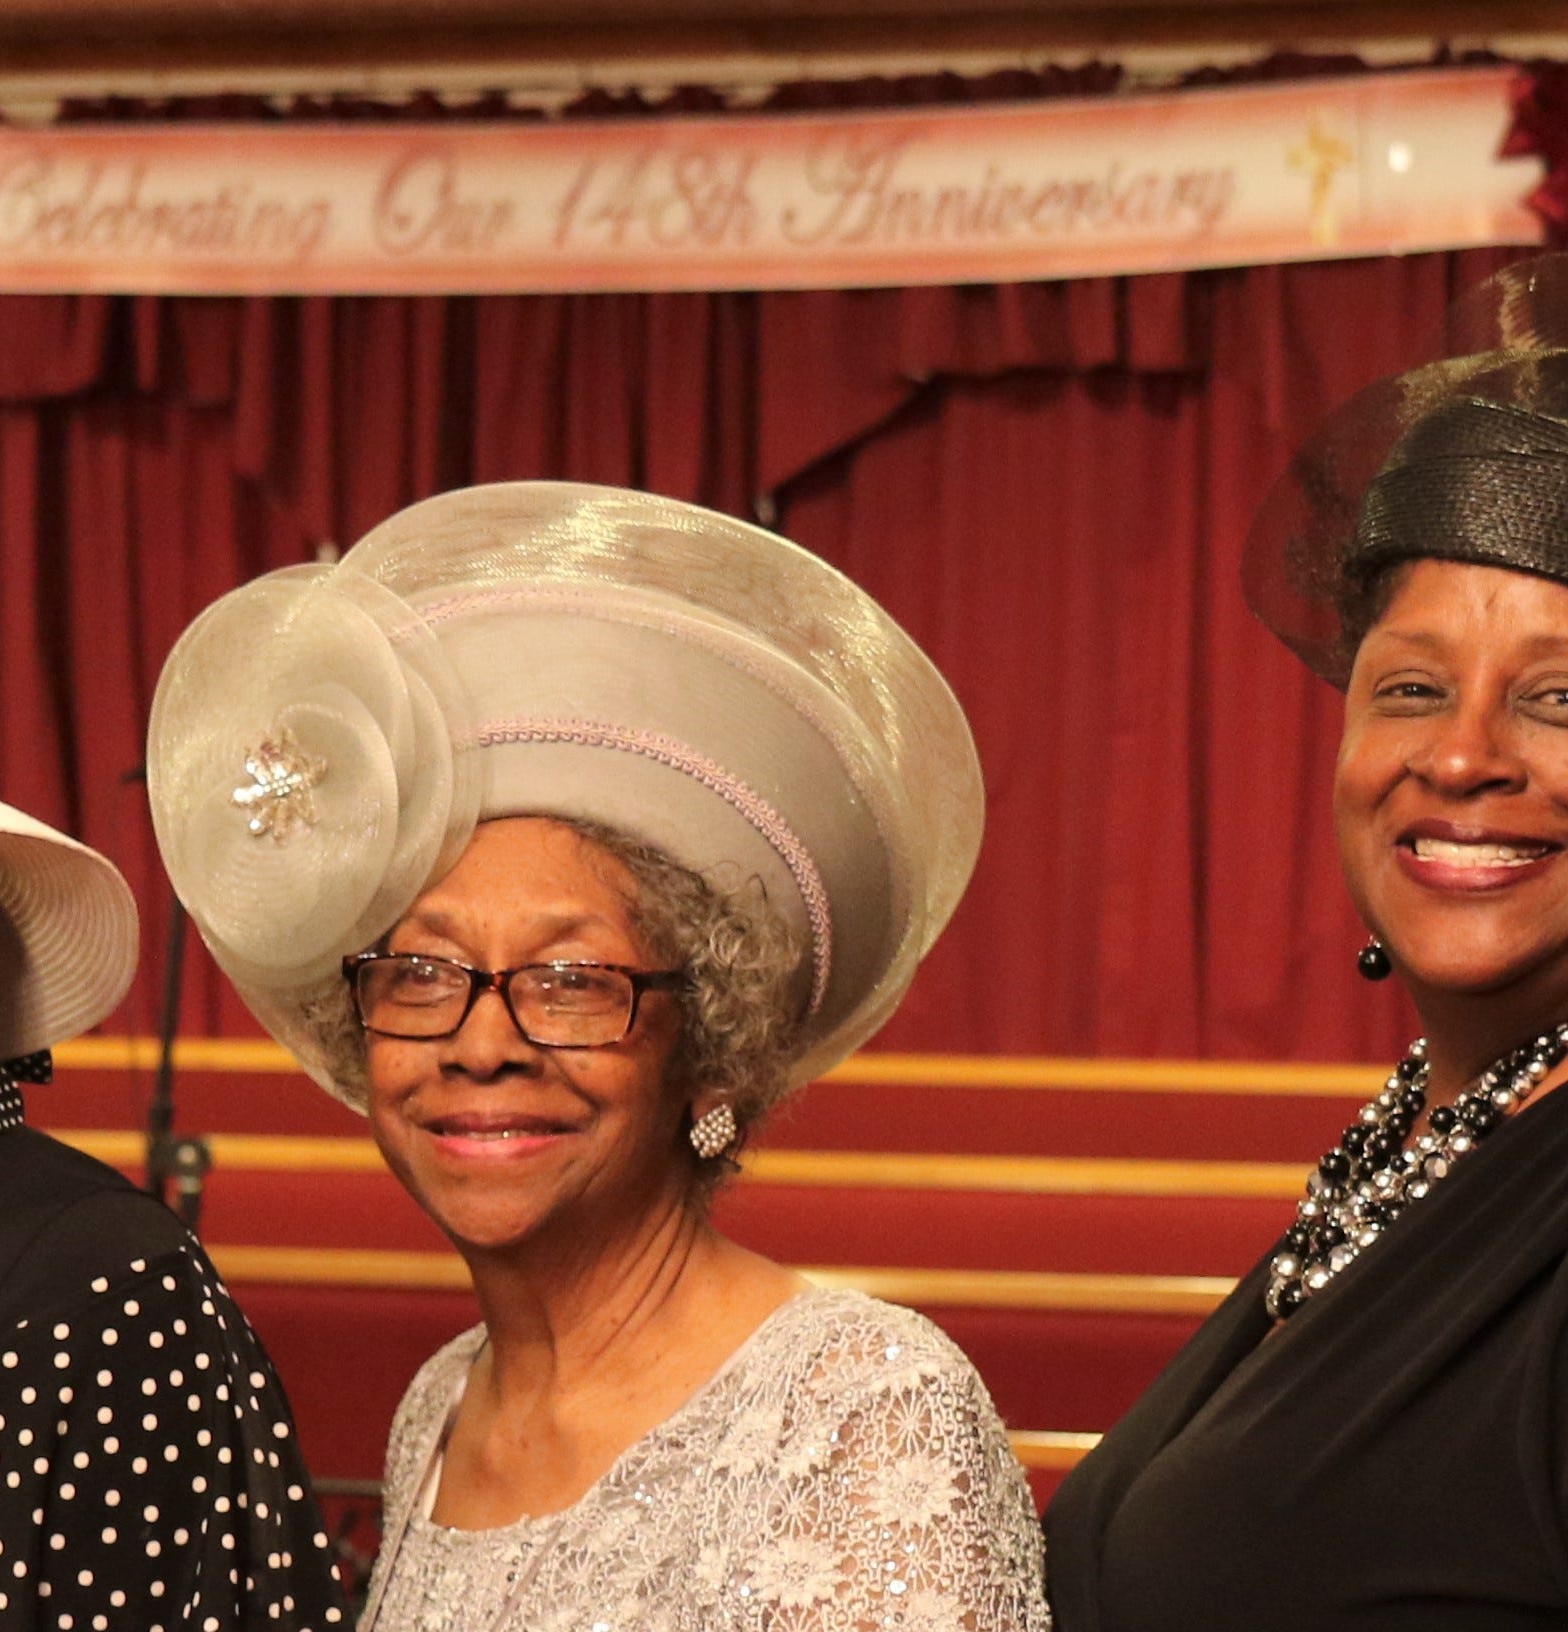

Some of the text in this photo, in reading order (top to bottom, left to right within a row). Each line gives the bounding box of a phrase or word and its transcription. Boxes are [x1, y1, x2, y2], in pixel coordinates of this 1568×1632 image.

[373, 140, 516, 254] Our
[551, 138, 759, 248] 148th
[779, 124, 1236, 243] Anniversary
